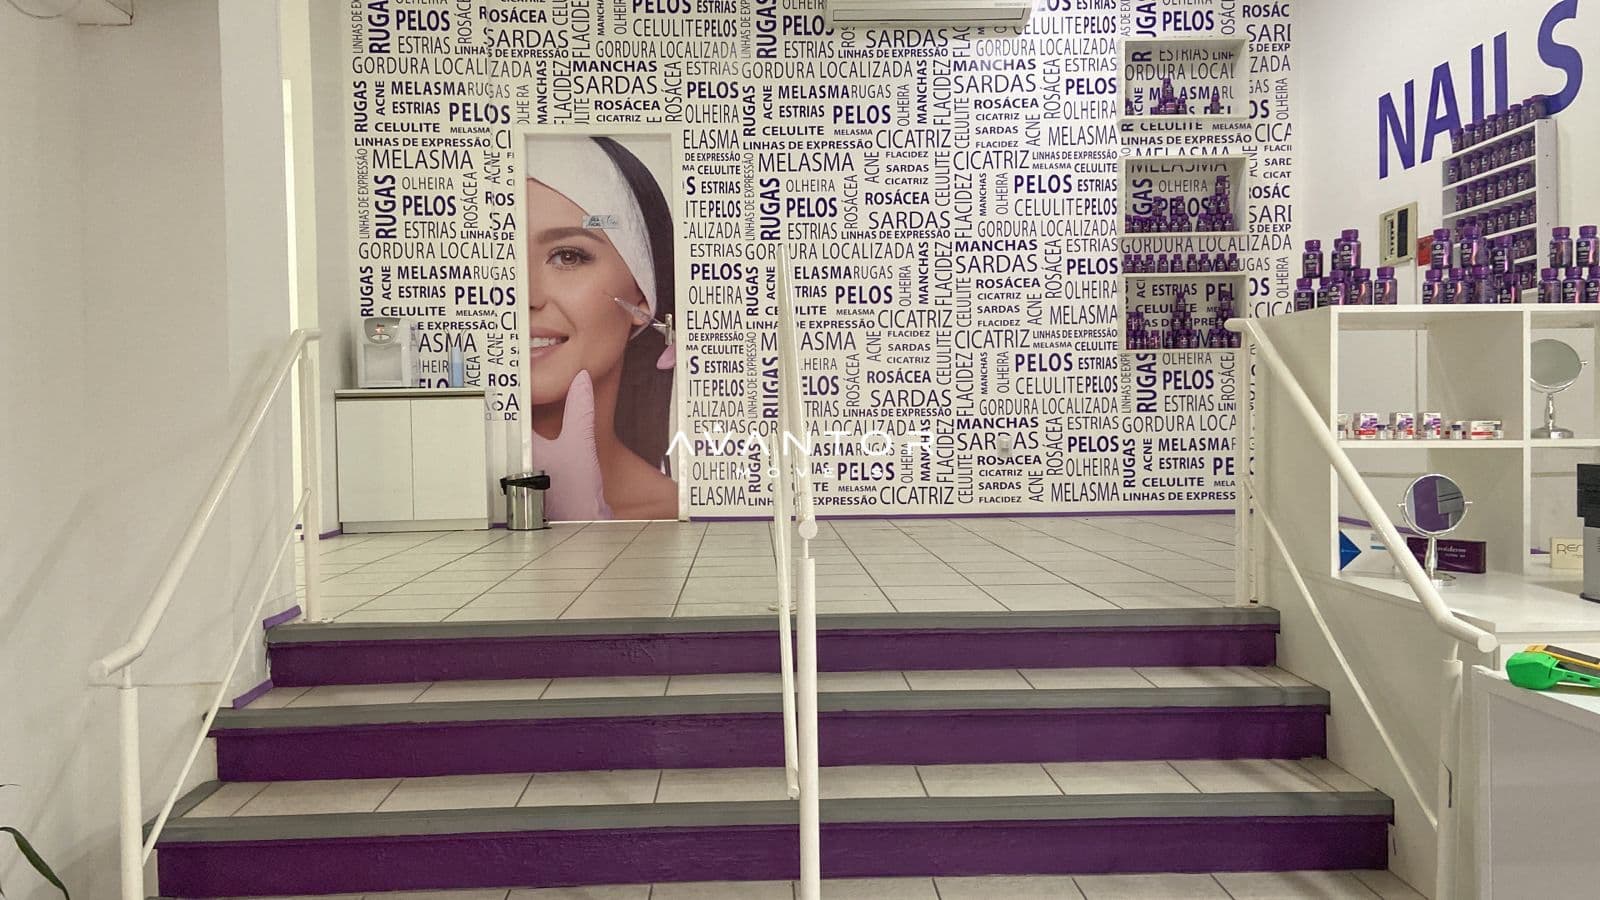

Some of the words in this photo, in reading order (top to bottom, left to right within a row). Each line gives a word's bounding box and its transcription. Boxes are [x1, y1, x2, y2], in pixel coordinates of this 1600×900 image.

[479, 6, 547, 23] ROSÁCEA
[697, 0, 737, 14] ESTRIAS
[704, 19, 737, 37] PELOS
[1084, 16, 1116, 34] PELOS
[1163, 10, 1214, 31] PELOS
[398, 36, 450, 54] ESTRIAS
[483, 27, 568, 48] SARDAS
[455, 44, 493, 58] LINHAS
[495, 49, 508, 58] DE
[511, 47, 569, 58] EXPRESSÃO
[596, 40, 656, 58] GORDURA
[660, 41, 737, 58] LOCALIZADA
[784, 40, 834, 58] ESTRIAS
[838, 49, 874, 58] LINHAS
[876, 49, 889, 58] DE
[892, 46, 948, 58] EXPRESSÃO
[976, 38, 1036, 57] GORDURA
[1040, 37, 1116, 56] LOCALIZADA
[352, 56, 430, 74] GORDURA
[435, 56, 532, 78] LOCALIZADA
[573, 60, 657, 72] MANCHAS
[742, 61, 815, 79] GORDURA
[820, 61, 913, 78] LOCALIZADA
[953, 58, 1036, 72] MANCHAS
[574, 76, 657, 94] SARDAS
[687, 81, 739, 98] PELOS
[778, 85, 850, 99] MELASMA
[851, 84, 891, 99] RUGAS
[1039, 58, 1061, 120] ROSÁCEA
[1066, 77, 1116, 95] PELOS
[353, 81, 368, 132] RUGAS
[392, 101, 440, 114] ESTRIAS
[594, 97, 660, 110] ROSÁCEA
[742, 86, 756, 136] RUGAS
[779, 105, 824, 118] ESTRIAS
[974, 98, 1039, 109] ROSÁCEA
[833, 105, 891, 124] PELOS
[375, 122, 440, 133] CELULITE
[762, 126, 824, 136] CELULITE
[975, 126, 1018, 135] SARDAS
[1048, 125, 1117, 146] MELASMA
[355, 138, 399, 146] LINHAS
[402, 138, 418, 147] DE
[422, 138, 490, 147] EXPRESSÃO
[743, 141, 785, 150] LINHAS
[788, 141, 803, 150] DE
[807, 139, 873, 149] EXPRESSÃO
[876, 129, 951, 149] CICATRIZ
[1121, 136, 1163, 145] LINHAS
[1166, 136, 1181, 144] DE
[1185, 134, 1252, 144] EXPRESSÃO
[373, 149, 473, 169] MELASMA
[685, 153, 695, 161] DE
[697, 151, 740, 161] EXPRESSÃO
[759, 152, 854, 172] MELASMA
[1032, 151, 1060, 160] LINHAS
[1062, 151, 1072, 160] DE
[1074, 149, 1117, 160] EXPRESSÃO
[697, 165, 741, 175] CELULITE
[786, 179, 835, 192] OLHEIRA
[1014, 174, 1072, 194] PELOS
[1158, 179, 1208, 193] OLHEIRA
[403, 195, 456, 216] PELOS
[460, 172, 478, 228] ROSÁCEA
[841, 174, 858, 229] ROSÁCEA
[865, 189, 929, 205] ROSÁCEA
[709, 200, 741, 218] PELOS
[787, 197, 837, 218] PELOS
[1015, 198, 1083, 216] CELULITE
[460, 230, 499, 240] LINHAS
[501, 232, 514, 240] DE
[788, 222, 837, 240] ESTRIAS
[841, 231, 877, 239] LINHAS
[879, 230, 892, 239] DE
[894, 227, 950, 239] EXPRESSÃO
[978, 220, 1037, 238] GORDURA
[1041, 219, 1117, 237] LOCALIZADA
[359, 242, 435, 259] GORDURA
[822, 242, 914, 259] LOCALIZADA
[1066, 238, 1119, 252] ESTRIAS
[1121, 238, 1194, 254] GORDURA
[1199, 234, 1292, 252] LOCALIZADA
[398, 266, 472, 279] MELASMA
[691, 263, 742, 280] PELOS
[854, 265, 893, 279] RUGAS
[956, 254, 1037, 274] SARDAS
[1067, 258, 1118, 275] PELOS
[473, 266, 515, 280] RUGAS
[1276, 256, 1289, 298] OLHEIRA
[381, 266, 391, 300] ACNE
[899, 265, 912, 307] OLHEIRA
[976, 276, 1040, 289] ROSÁCEA
[455, 286, 515, 306] PELOS
[836, 285, 892, 304] PELOS
[1026, 293, 1042, 325] ACNE
[1050, 304, 1118, 325] MELASMA
[428, 320, 498, 330] EXPRESSÃO
[809, 319, 875, 329] EXPRESSÃO
[878, 309, 952, 328] CICATRIZ
[978, 319, 1020, 327] FLACIDEZ
[689, 333, 699, 341] DE
[700, 331, 744, 341] EXPRESSÃO
[1033, 330, 1061, 339] LINHAS
[1062, 330, 1072, 338] DE
[1074, 327, 1118, 338] EXPRESSÃO
[701, 345, 744, 355] CELULITE
[888, 343, 931, 351] SARDAS
[1015, 353, 1073, 372] PELOS
[1162, 352, 1212, 365] OLHEIRA
[867, 368, 931, 383] ROSÁCEA
[1136, 353, 1157, 413] RUGAS
[1163, 369, 1214, 390] PELOS
[712, 379, 744, 397] PELOS
[1016, 376, 1084, 395] CELULITE
[871, 389, 952, 407] SARDAS
[979, 398, 1039, 416] GORDURA
[1042, 397, 1118, 415] LOCALIZADA
[1164, 394, 1214, 412] ESTRIAS
[843, 409, 878, 417] LINHAS
[881, 408, 893, 417] DE
[896, 405, 952, 417] EXPRESSÃO
[956, 415, 1039, 430] MANCHAS
[1122, 415, 1195, 433] GORDURA
[1068, 435, 1119, 453] PELOS
[1158, 437, 1230, 451] MELASMA
[748, 443, 761, 492] RUGAS
[1159, 457, 1204, 469] ESTRIAS
[957, 454, 973, 504] CELULITE
[978, 482, 1021, 490] SARDAS
[1142, 477, 1204, 487] CELULITE
[1051, 482, 1120, 502] MELASMA
[1123, 492, 1165, 501] LINHAS
[1168, 492, 1183, 500] DE
